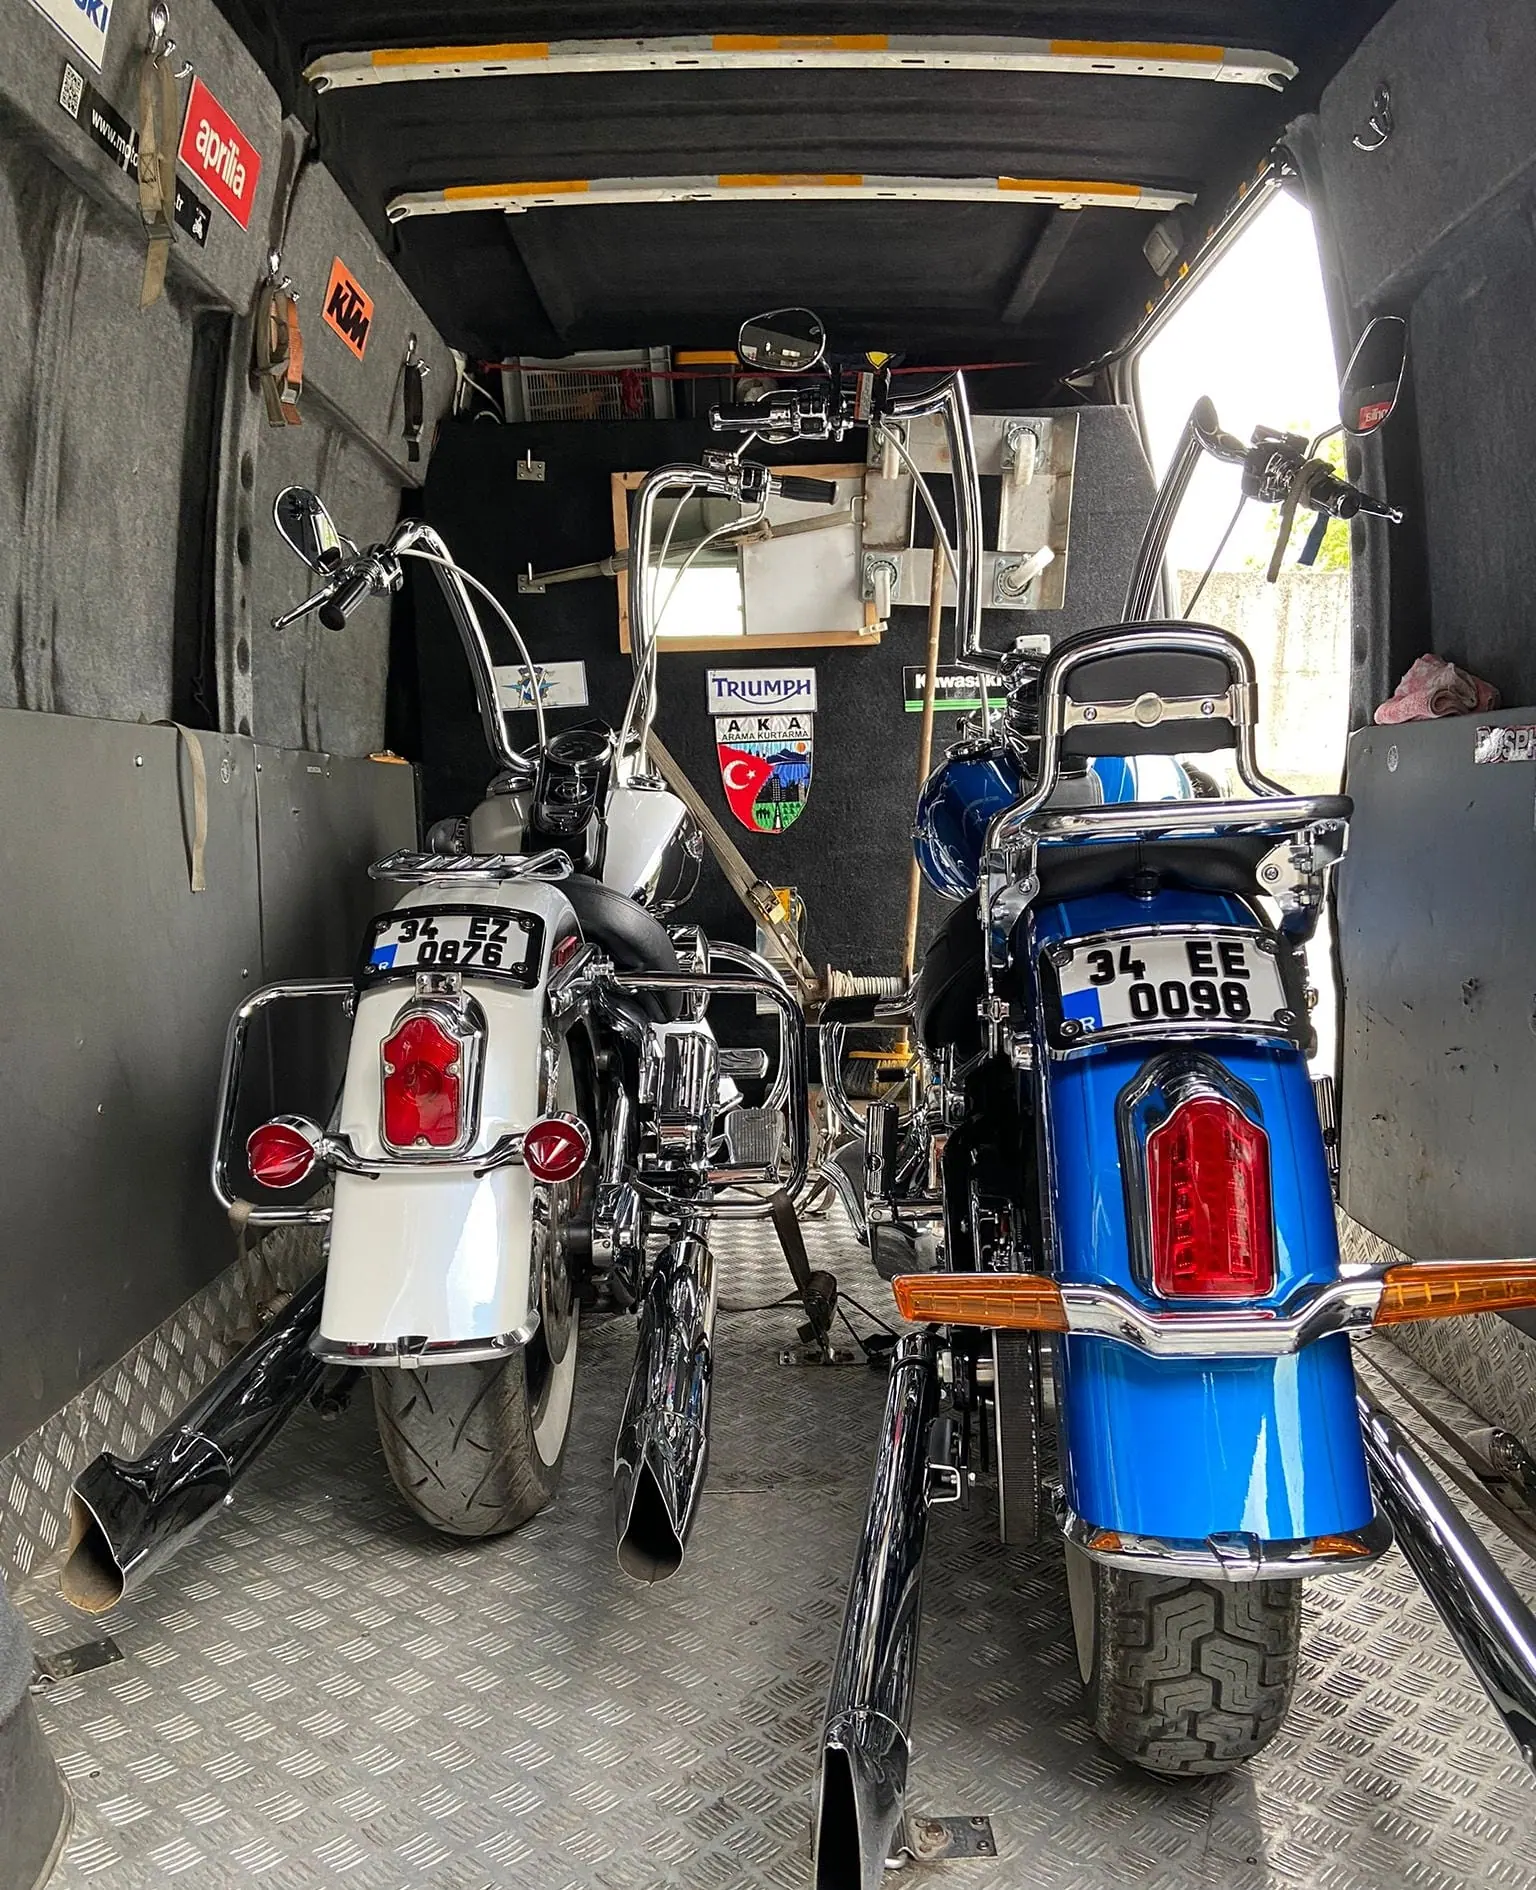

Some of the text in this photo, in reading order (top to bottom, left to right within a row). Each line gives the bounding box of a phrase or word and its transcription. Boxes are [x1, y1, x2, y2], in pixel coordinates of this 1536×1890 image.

[195, 118, 247, 200] aprilia
[327, 279, 370, 352] KTM
[712, 677, 811, 698] TRIUMPH
[915, 672, 1004, 689] Kwaski
[721, 729, 809, 741] ARAMA KURTARMA
[397, 917, 511, 944] 34 EZ
[378, 961, 389, 971] R
[416, 939, 503, 968] 0876
[1086, 940, 1251, 986] 34 EE
[1128, 980, 1252, 1021] 0098
[1079, 1016, 1096, 1032] R
